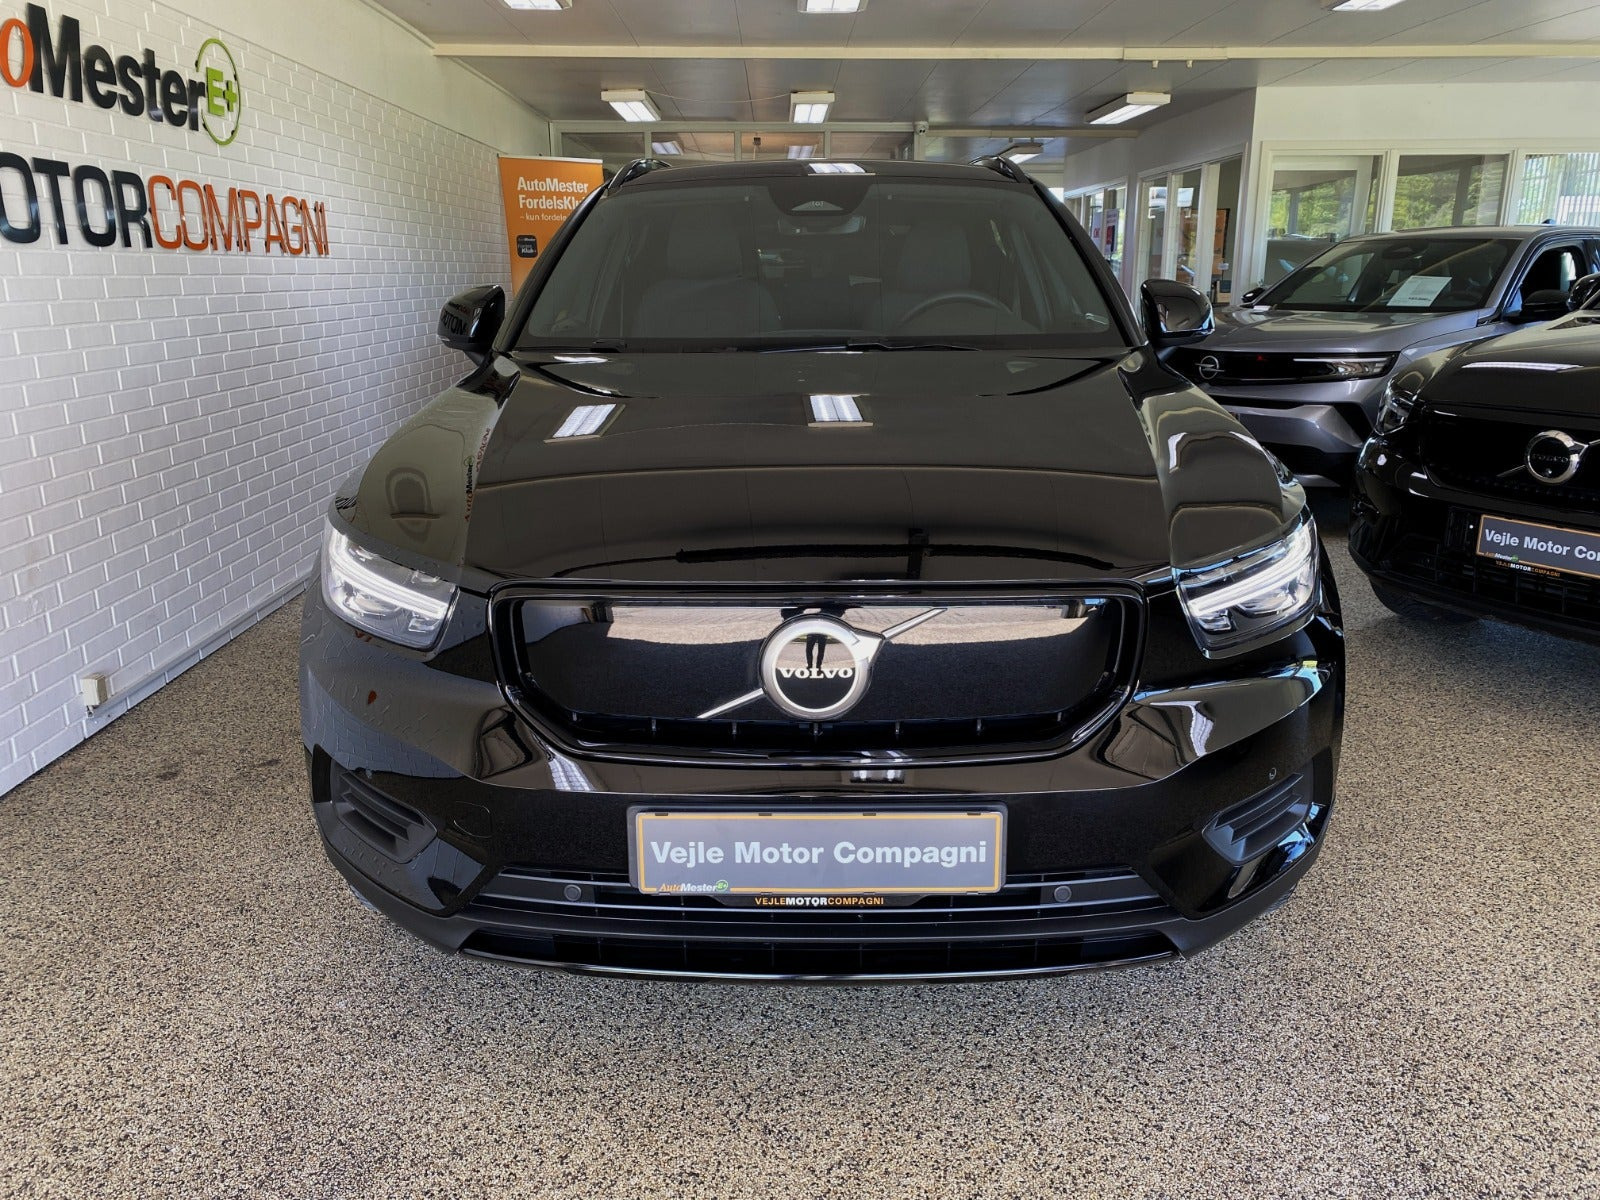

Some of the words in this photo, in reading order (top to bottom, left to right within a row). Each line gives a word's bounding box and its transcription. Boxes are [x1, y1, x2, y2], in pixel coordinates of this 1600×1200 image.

[517, 176, 589, 193] AutoMester
[525, 211, 540, 221] kun
[1485, 528, 1519, 546] Vejle
[1523, 535, 1570, 556] Motor
[1574, 545, 1600, 562] Co
[779, 667, 853, 679] VOLVO
[650, 841, 724, 868] Vejle
[734, 841, 824, 864] Motor
[833, 841, 986, 868] Compagni
[659, 883, 717, 892] AutoMester
[755, 897, 884, 906] VEJLEMOTORCOMPAGNI
